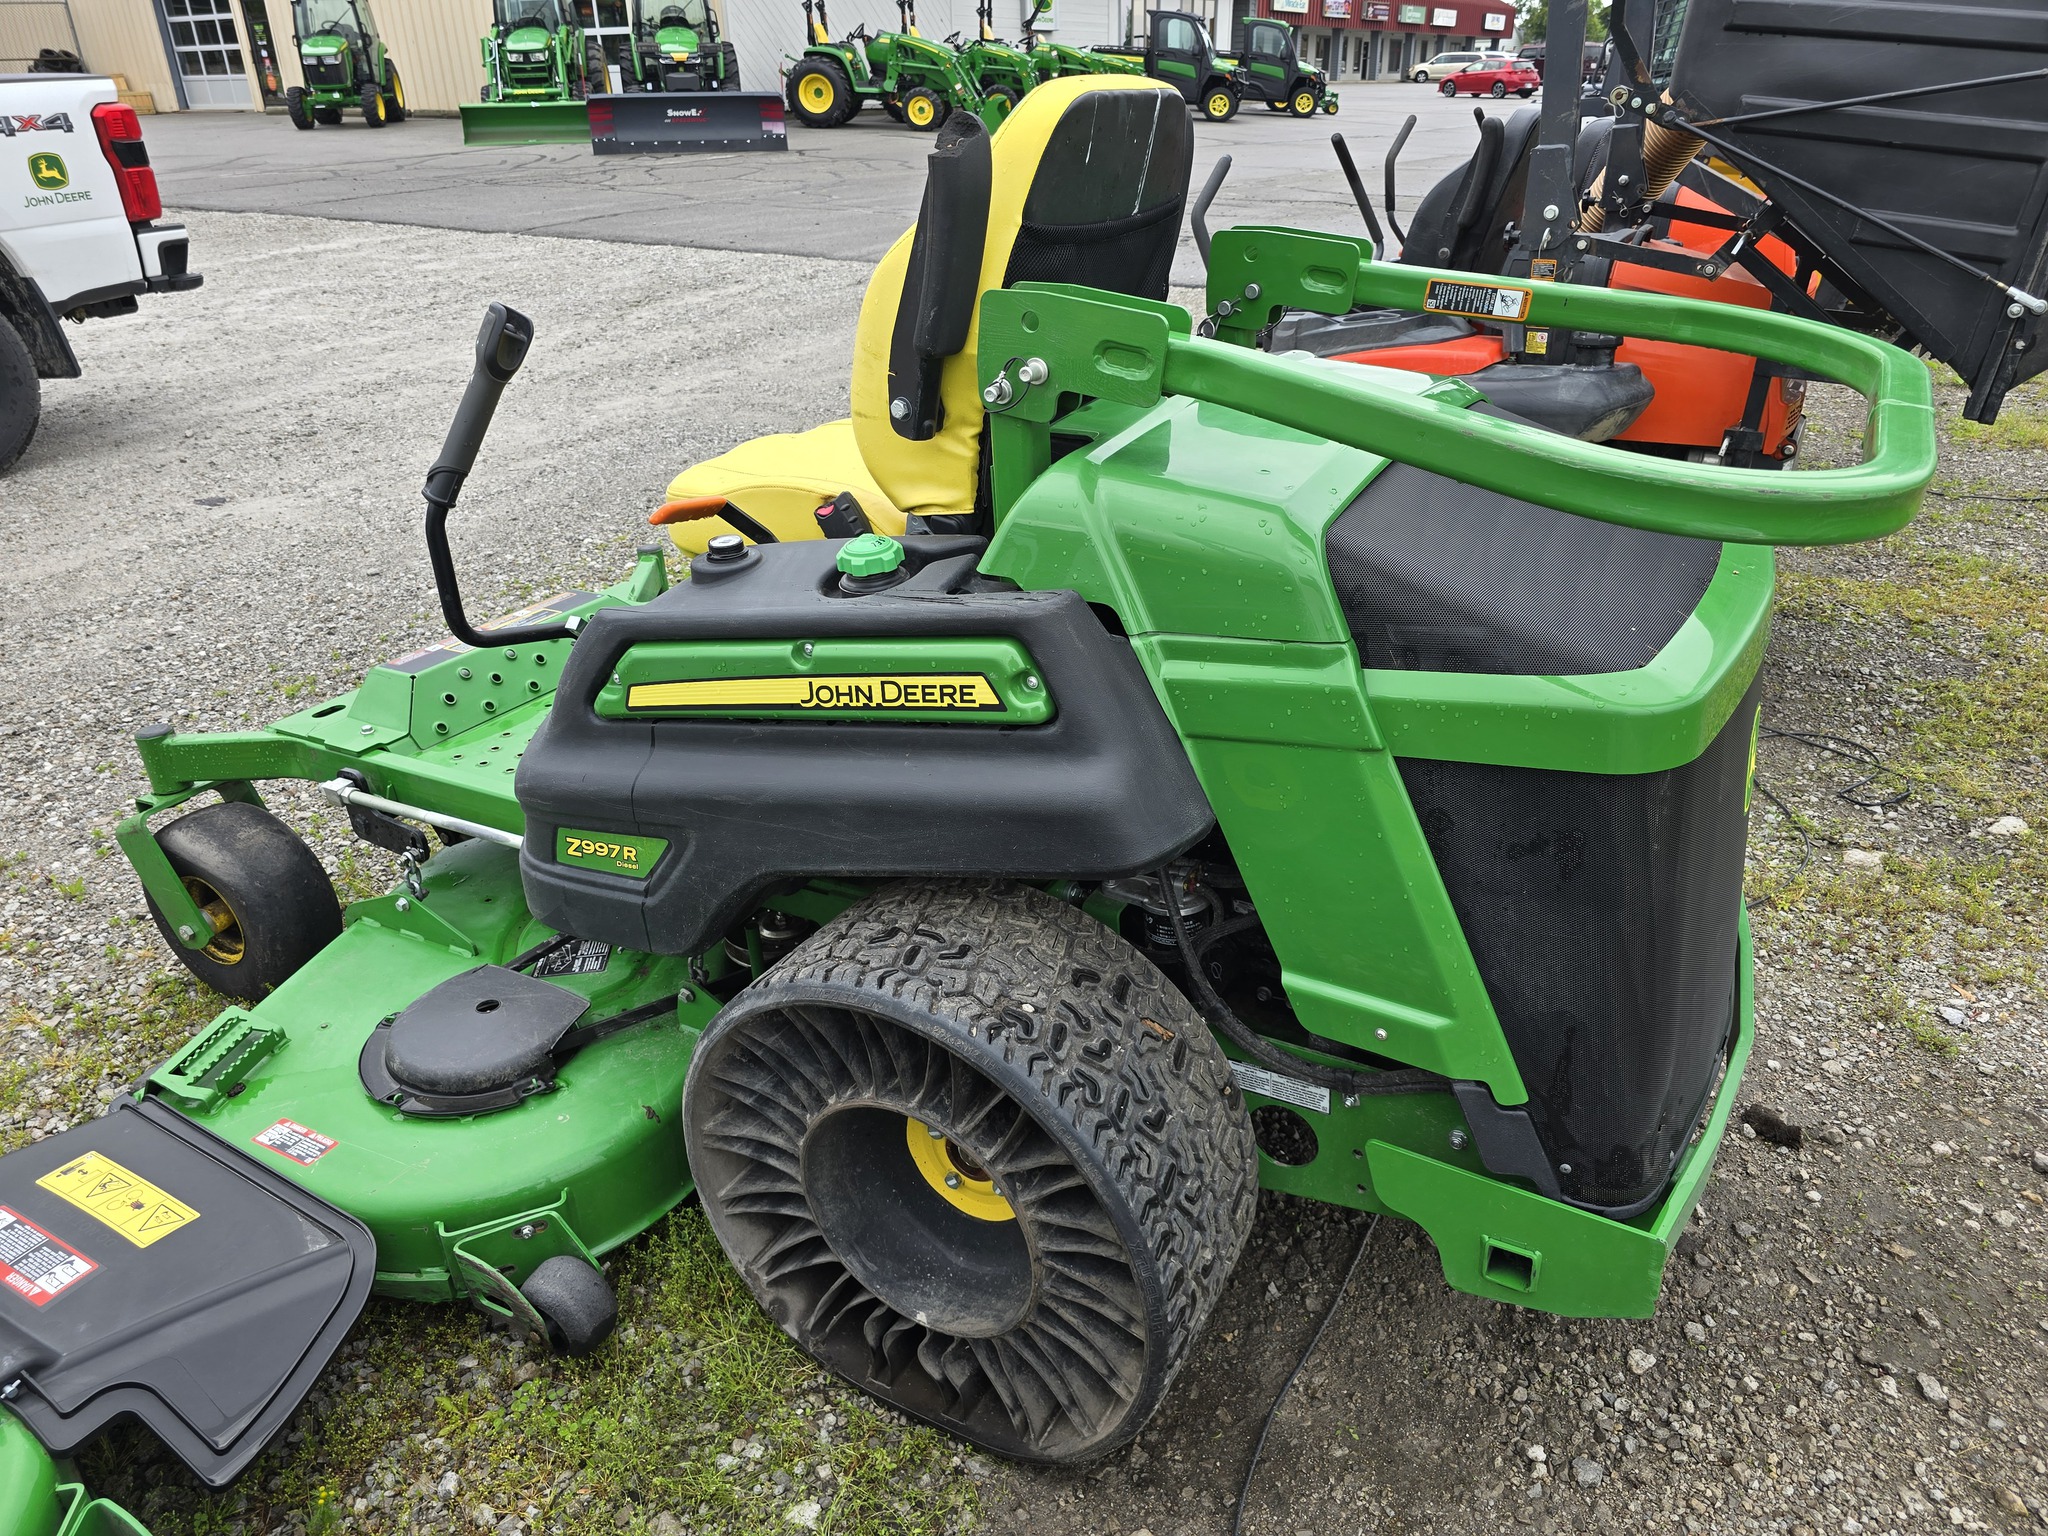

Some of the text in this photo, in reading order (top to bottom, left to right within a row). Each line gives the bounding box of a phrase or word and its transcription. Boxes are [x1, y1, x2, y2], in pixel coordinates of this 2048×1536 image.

[24, 191, 93, 208] JOHN DEERE
[801, 680, 977, 706] JOHN DEERE
[565, 836, 638, 862] Z997R
[616, 861, 639, 870] Diesel
[801, 987, 877, 1009] MICHELIN
[1008, 1079, 1029, 1098] NOT
[1031, 1095, 1050, 1116] FOR
[1050, 1116, 1088, 1160] HIGHWAY
[5, 1271, 34, 1295] DANGER
[1135, 1254, 1159, 1304] TWEEL
